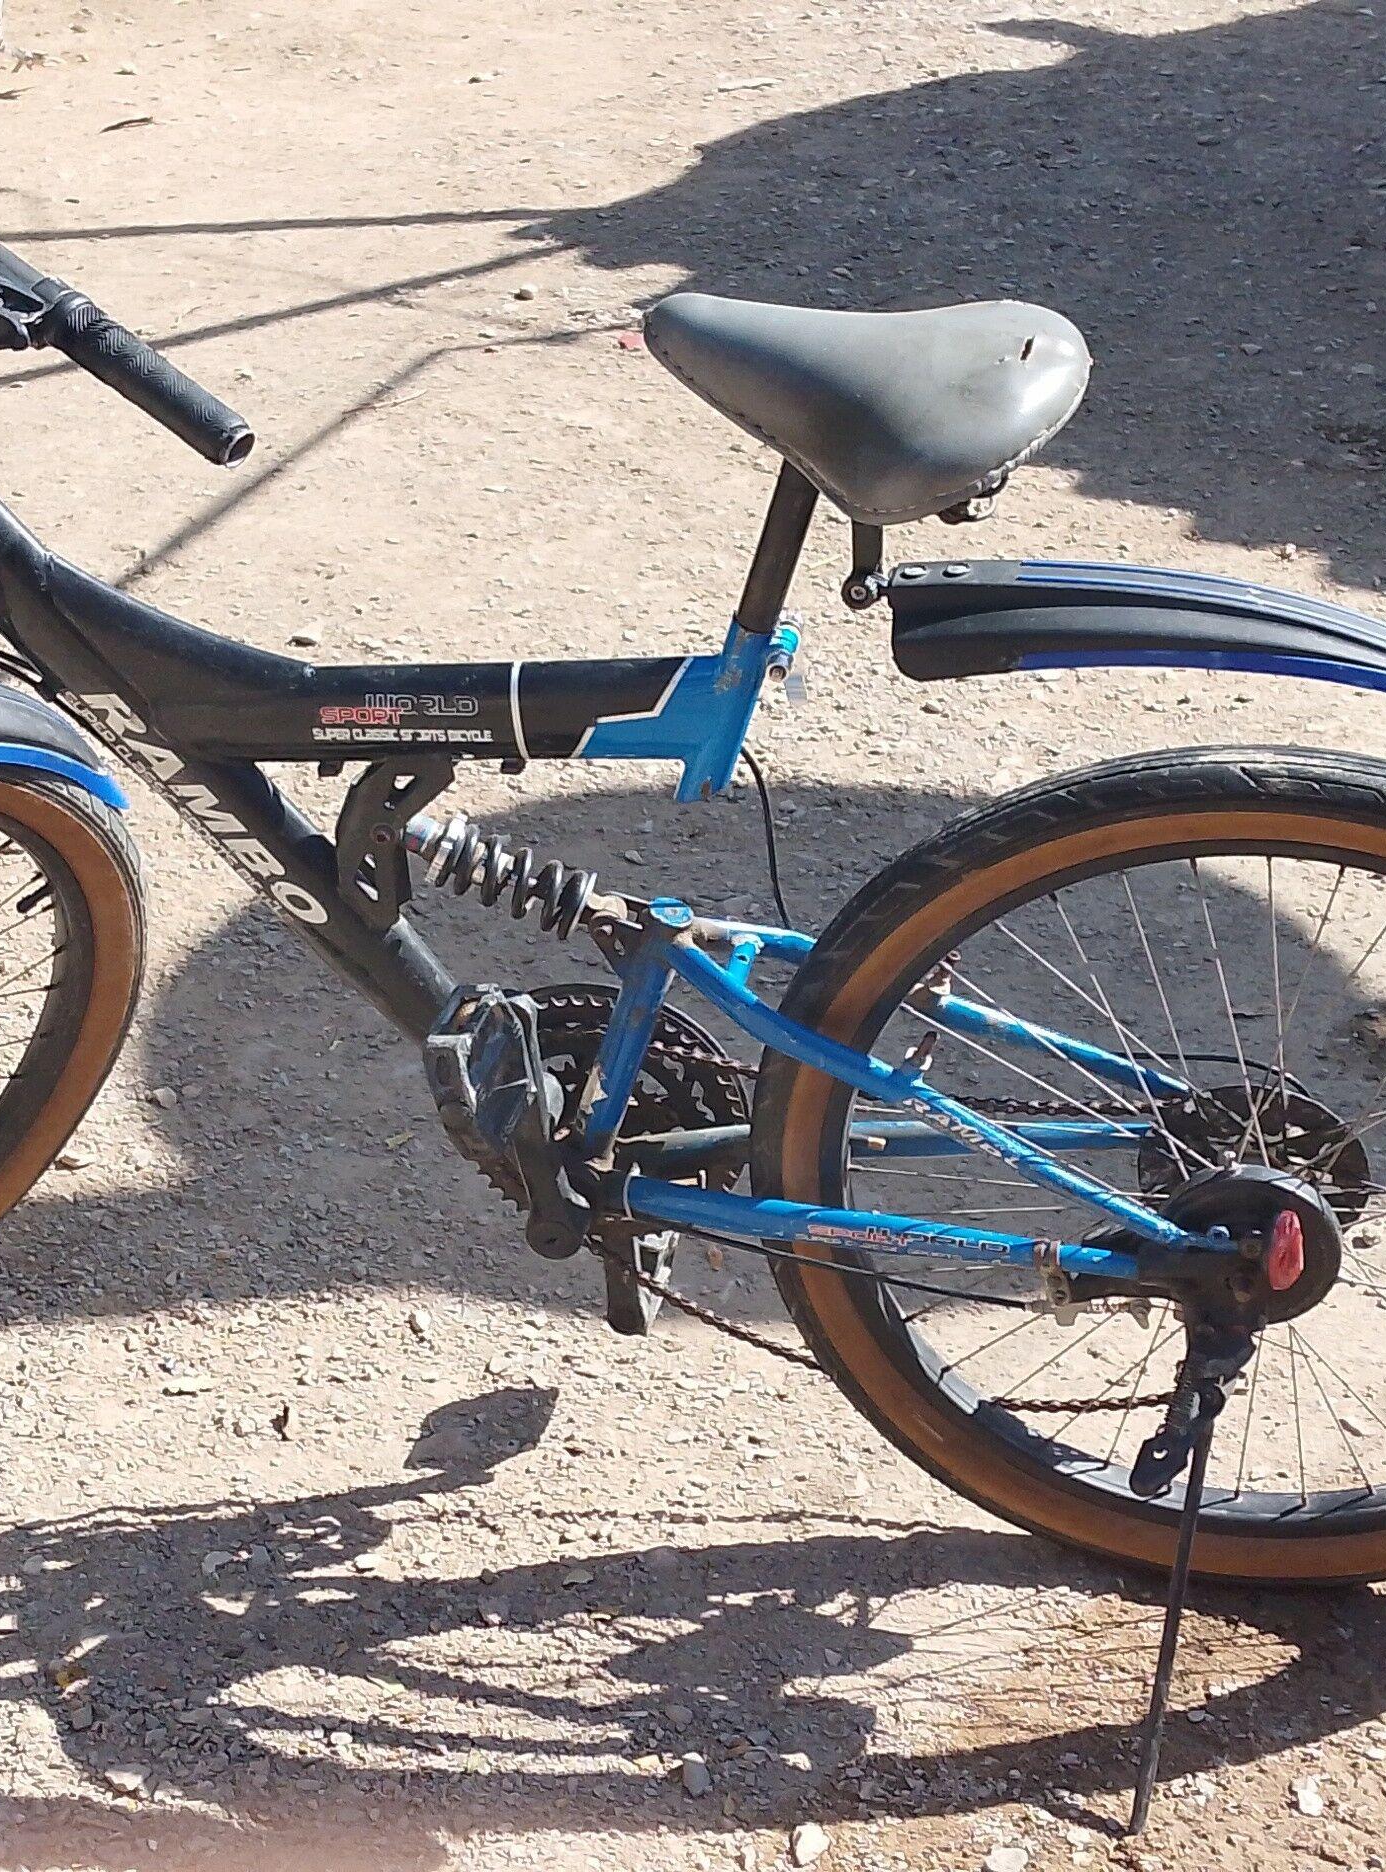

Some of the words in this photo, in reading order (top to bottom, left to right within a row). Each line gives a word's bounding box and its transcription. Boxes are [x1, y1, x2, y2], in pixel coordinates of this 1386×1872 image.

[319, 706, 403, 725] SPORT
[312, 727, 350, 742] SUPER
[78, 693, 328, 924] RAMBO
